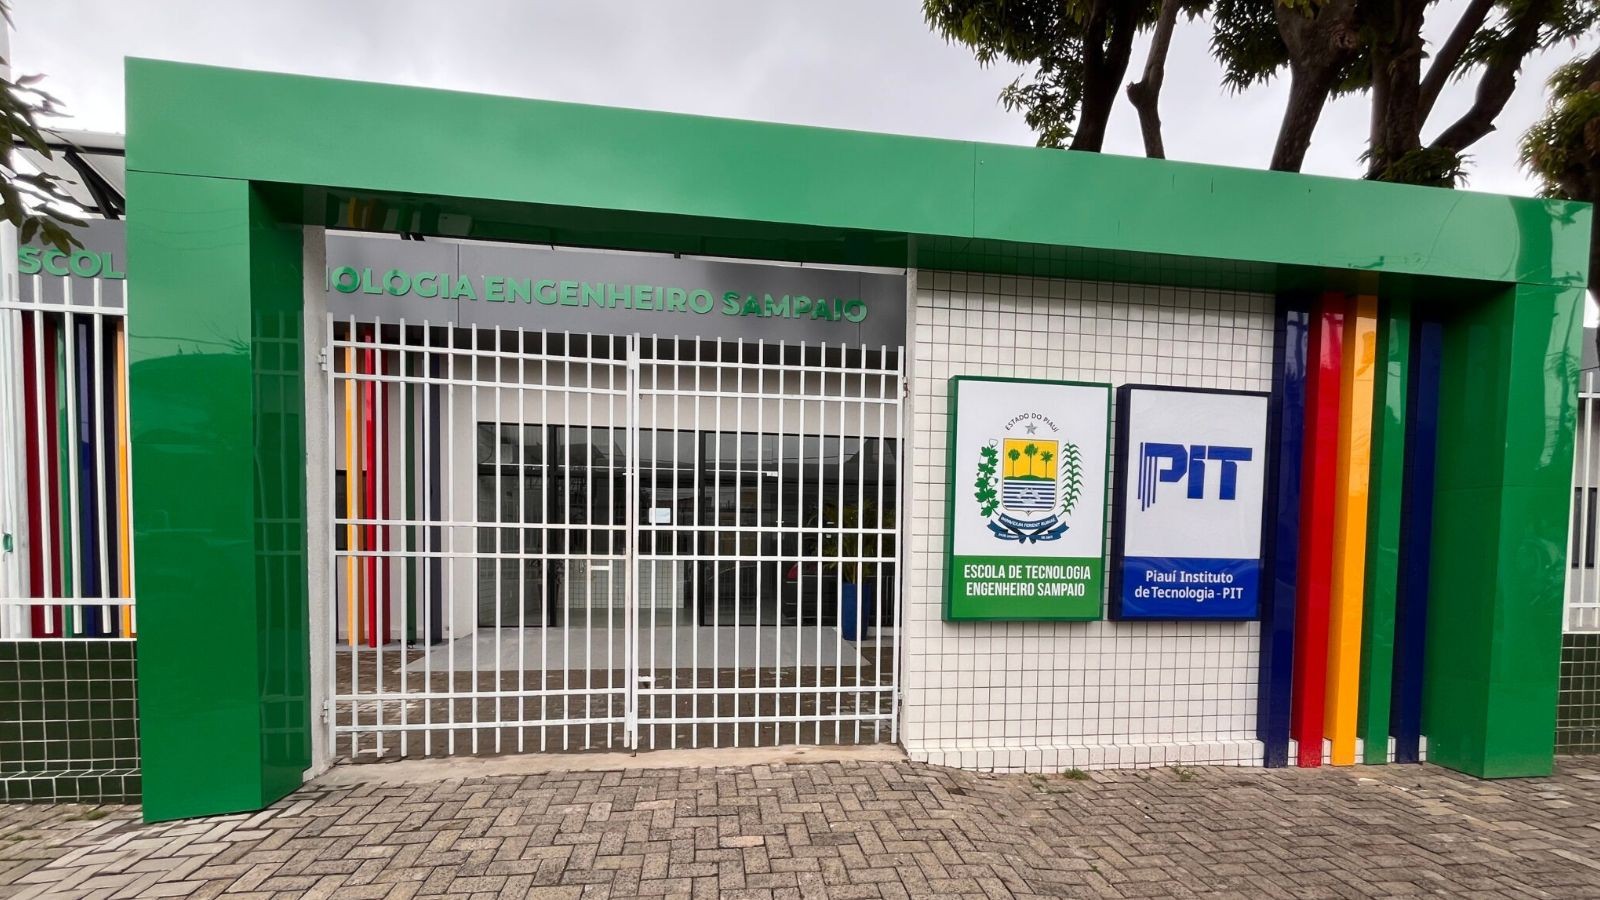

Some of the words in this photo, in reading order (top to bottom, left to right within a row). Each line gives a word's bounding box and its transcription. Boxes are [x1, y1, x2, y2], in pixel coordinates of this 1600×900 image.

[18, 245, 126, 279] SCOL
[326, 264, 477, 300] OLOGIA
[484, 274, 714, 314] ENGENHEIRO
[721, 290, 867, 323] SAMPAIO
[1005, 413, 1029, 431] ESTADO
[1031, 412, 1042, 420] DO
[1043, 416, 1060, 433] PIAUÍ
[1137, 442, 1253, 511] PIT
[964, 564, 1006, 579] ESCOLA
[1008, 565, 1023, 579] DE
[1025, 565, 1091, 580] TECNOLOGIA
[1145, 570, 1177, 583] Piauí
[1179, 570, 1234, 583] Instituto
[966, 582, 1035, 597] ENGENHEIRO
[1037, 582, 1085, 597] SAMPAIO
[1134, 585, 1150, 598] de
[1151, 586, 1215, 602] Tecnologia
